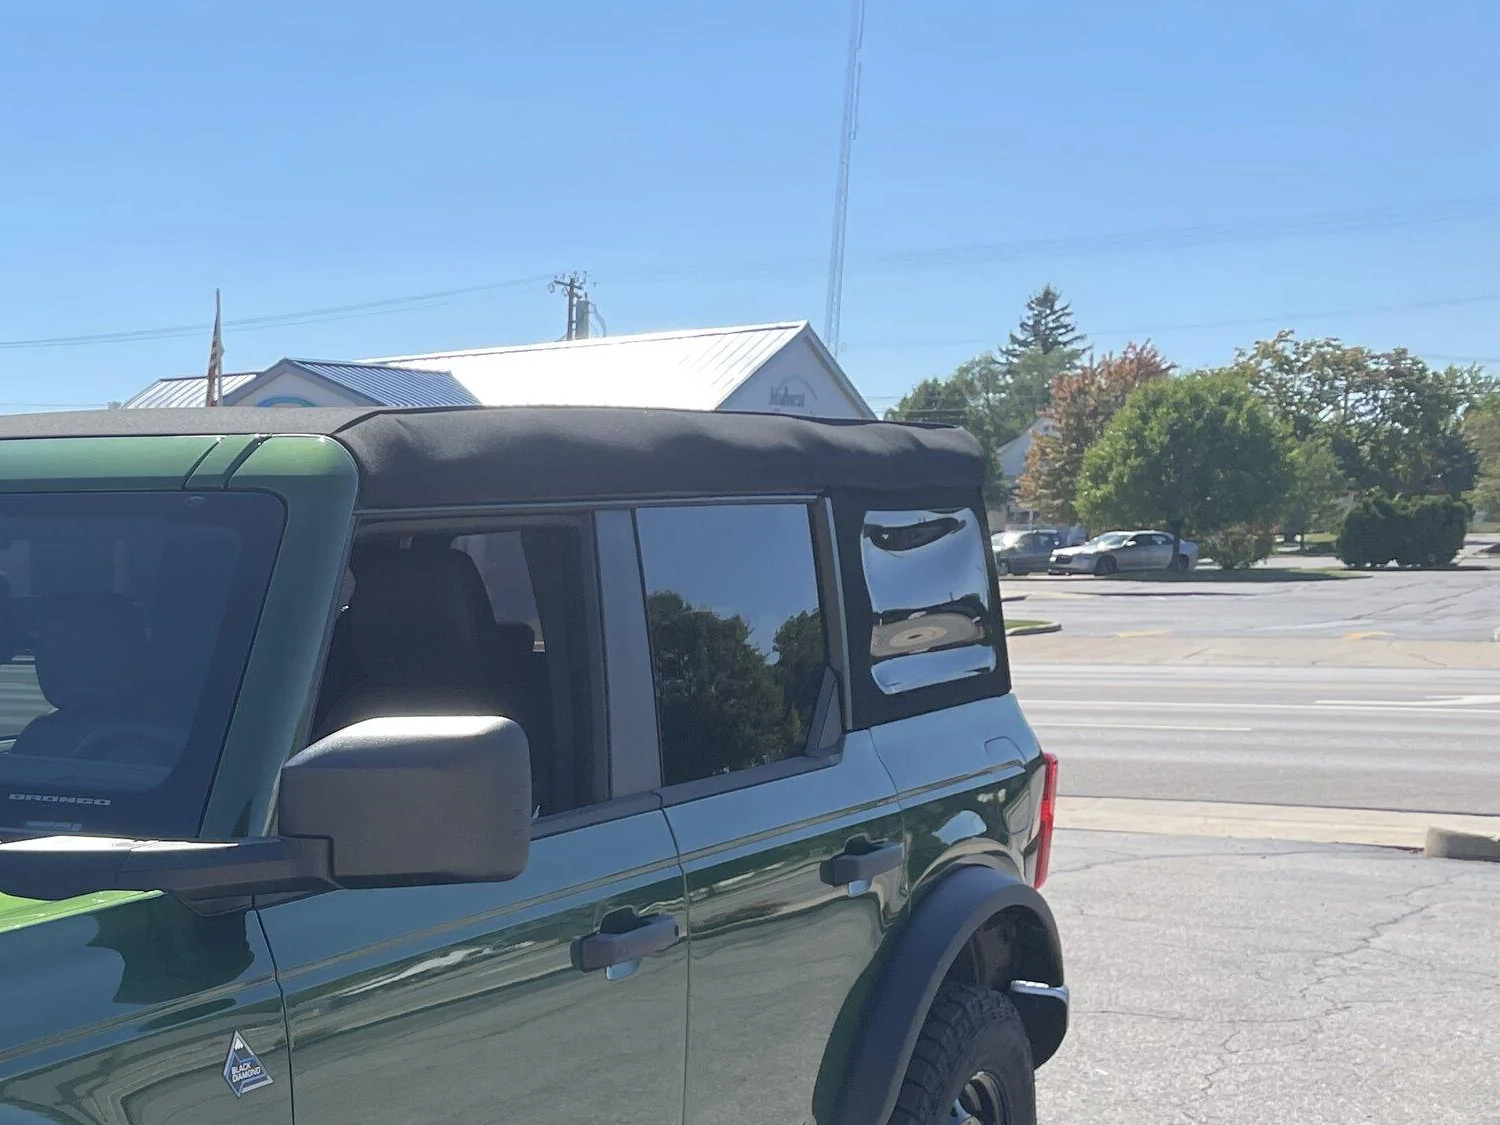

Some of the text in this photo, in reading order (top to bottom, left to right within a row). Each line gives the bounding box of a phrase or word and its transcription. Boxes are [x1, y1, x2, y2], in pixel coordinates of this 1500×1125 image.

[8, 793, 112, 806] BRONCO
[231, 1062, 251, 1075] BLACK
[231, 1066, 261, 1083] DIAMOND
